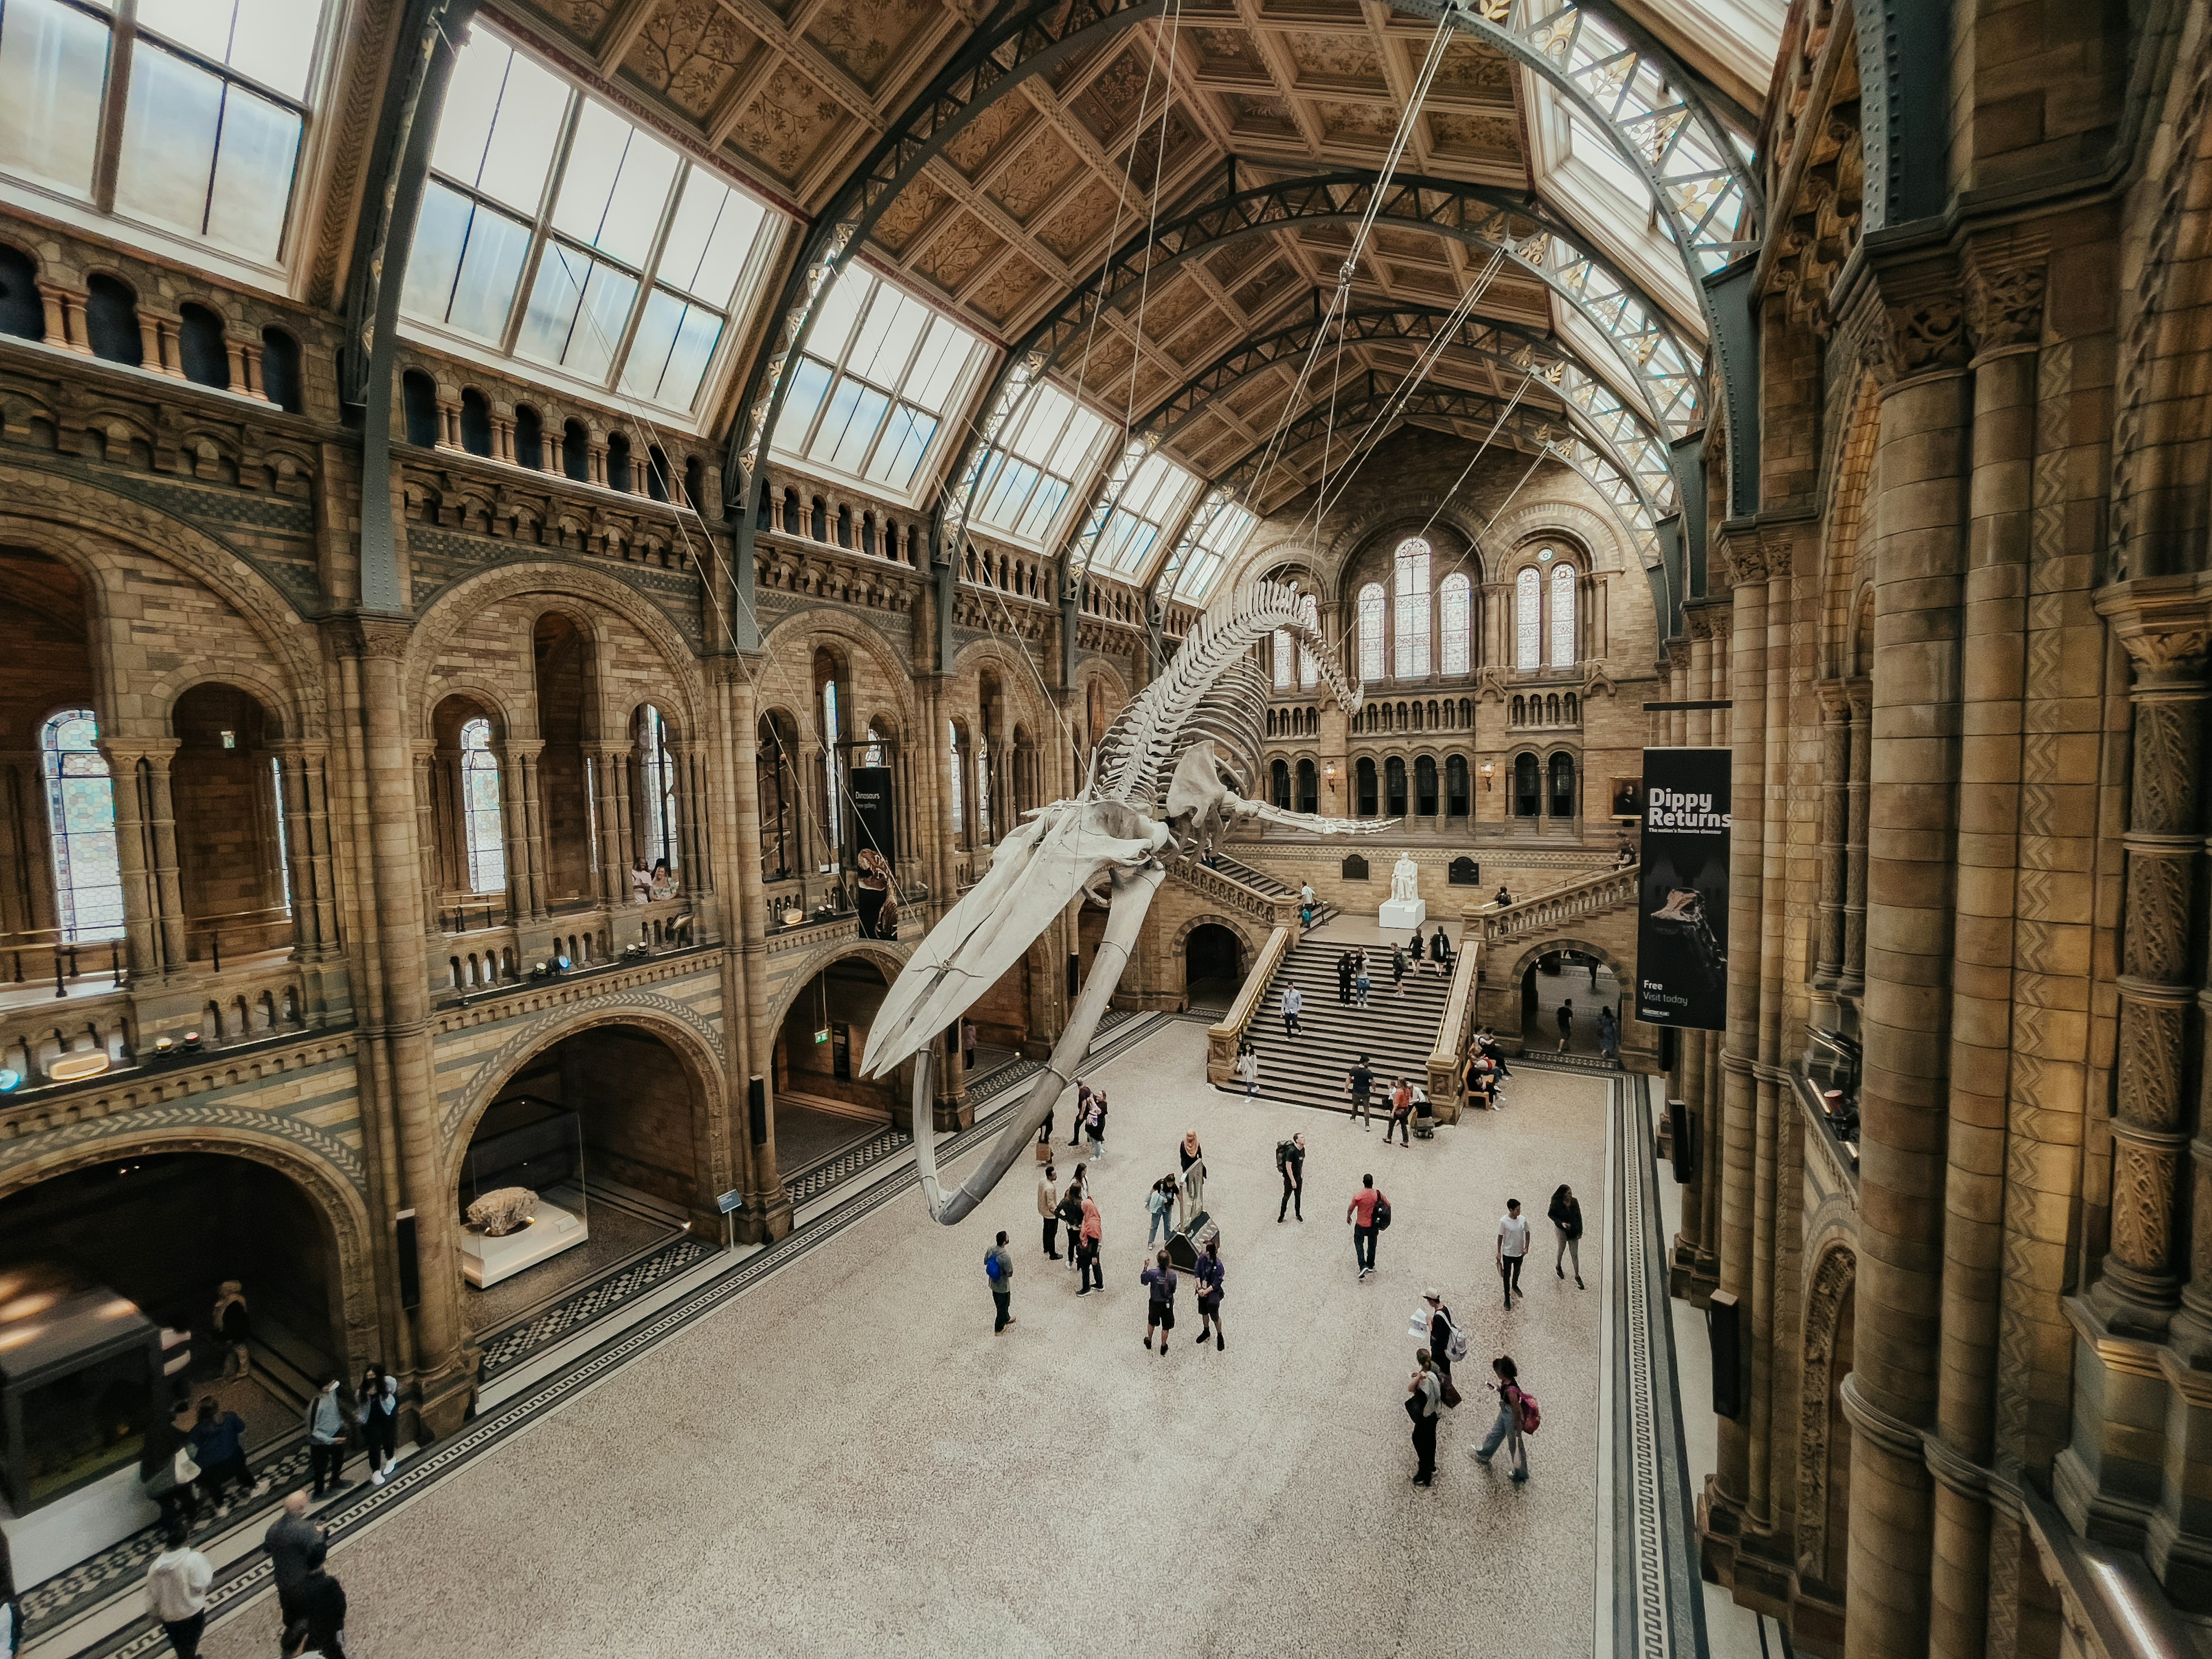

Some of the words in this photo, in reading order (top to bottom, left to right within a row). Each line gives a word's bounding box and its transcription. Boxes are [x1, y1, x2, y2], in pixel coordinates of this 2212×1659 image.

[855, 791, 880, 800] Dinosaurs
[1649, 787, 1712, 813] Dippy
[1649, 807, 1732, 828] Returns
[1643, 980, 1663, 990] Free
[1643, 991, 1661, 1002] Visit
[1663, 994, 1688, 1006] today
